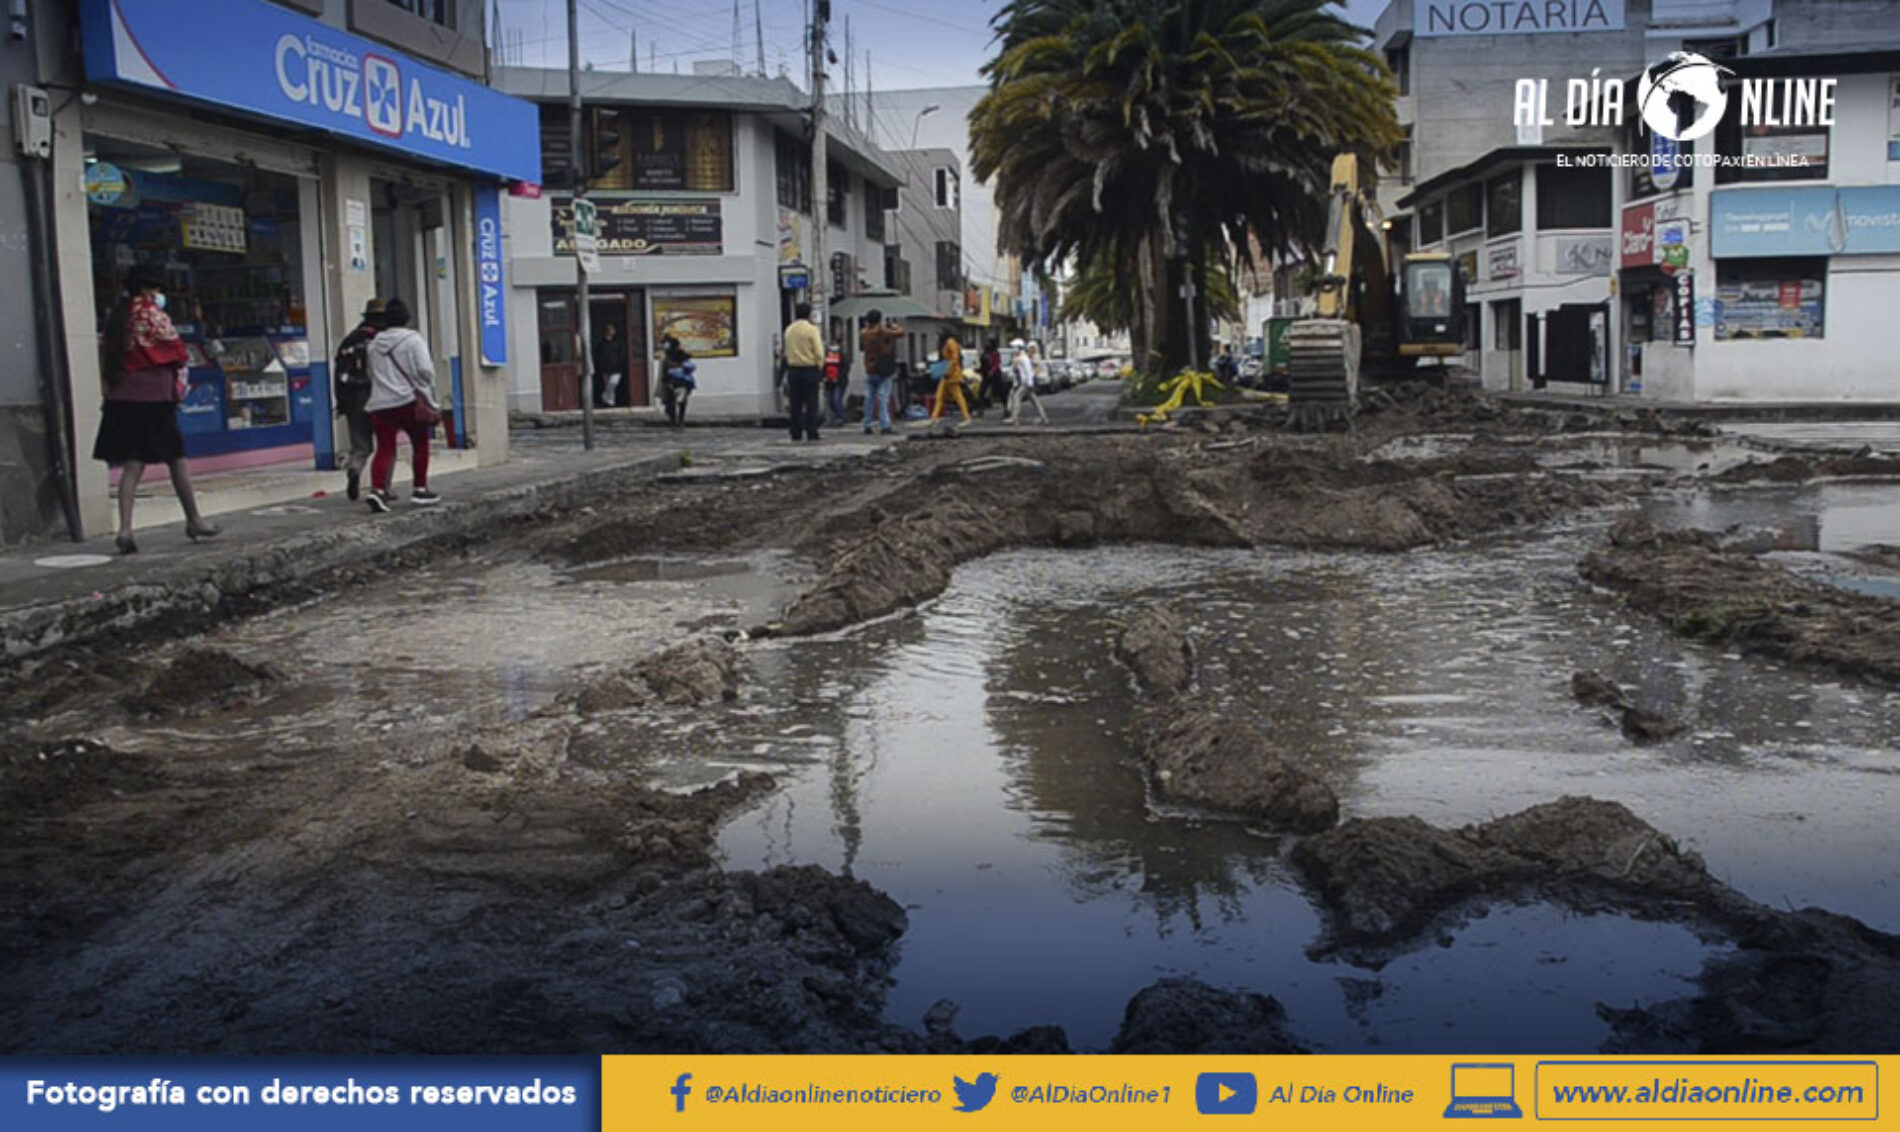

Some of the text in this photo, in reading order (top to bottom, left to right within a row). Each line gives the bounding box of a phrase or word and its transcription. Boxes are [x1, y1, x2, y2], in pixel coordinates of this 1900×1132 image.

[275, 34, 471, 149] Cruz Azul
[556, 238, 647, 249] AGADO
[1677, 274, 1691, 340] COPIAS
